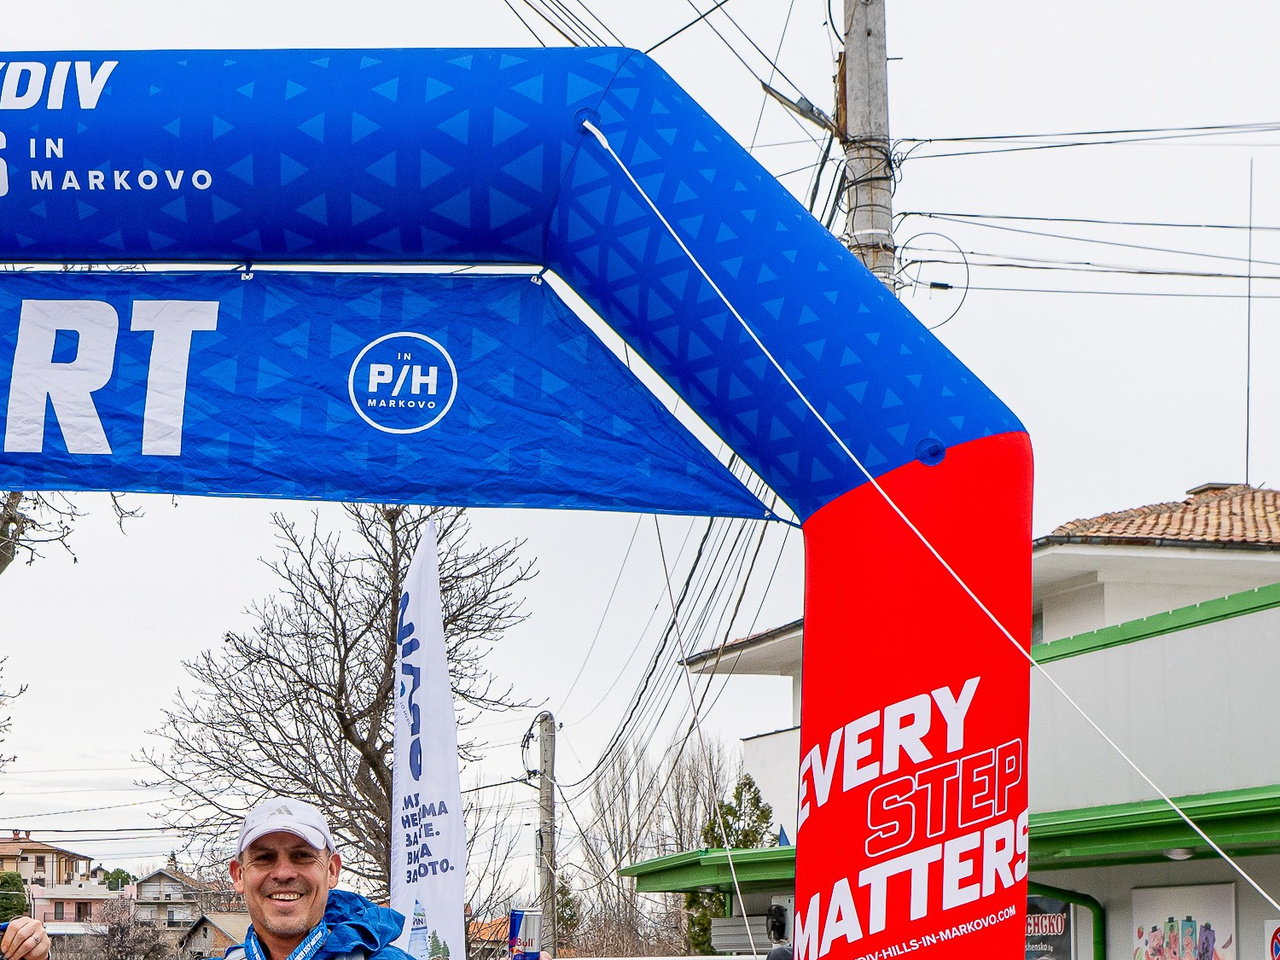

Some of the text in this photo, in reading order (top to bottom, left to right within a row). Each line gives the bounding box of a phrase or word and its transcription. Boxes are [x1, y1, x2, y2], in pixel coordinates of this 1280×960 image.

[30, 137, 64, 160] IN
[30, 168, 213, 191] MARKOVO
[397, 352, 412, 361] IN
[368, 363, 438, 397] P/H
[367, 398, 436, 409] MARKOVO
[797, 676, 981, 833] EVERY
[865, 738, 1022, 858] STEP
[1025, 913, 1065, 937] ЕНСКО
